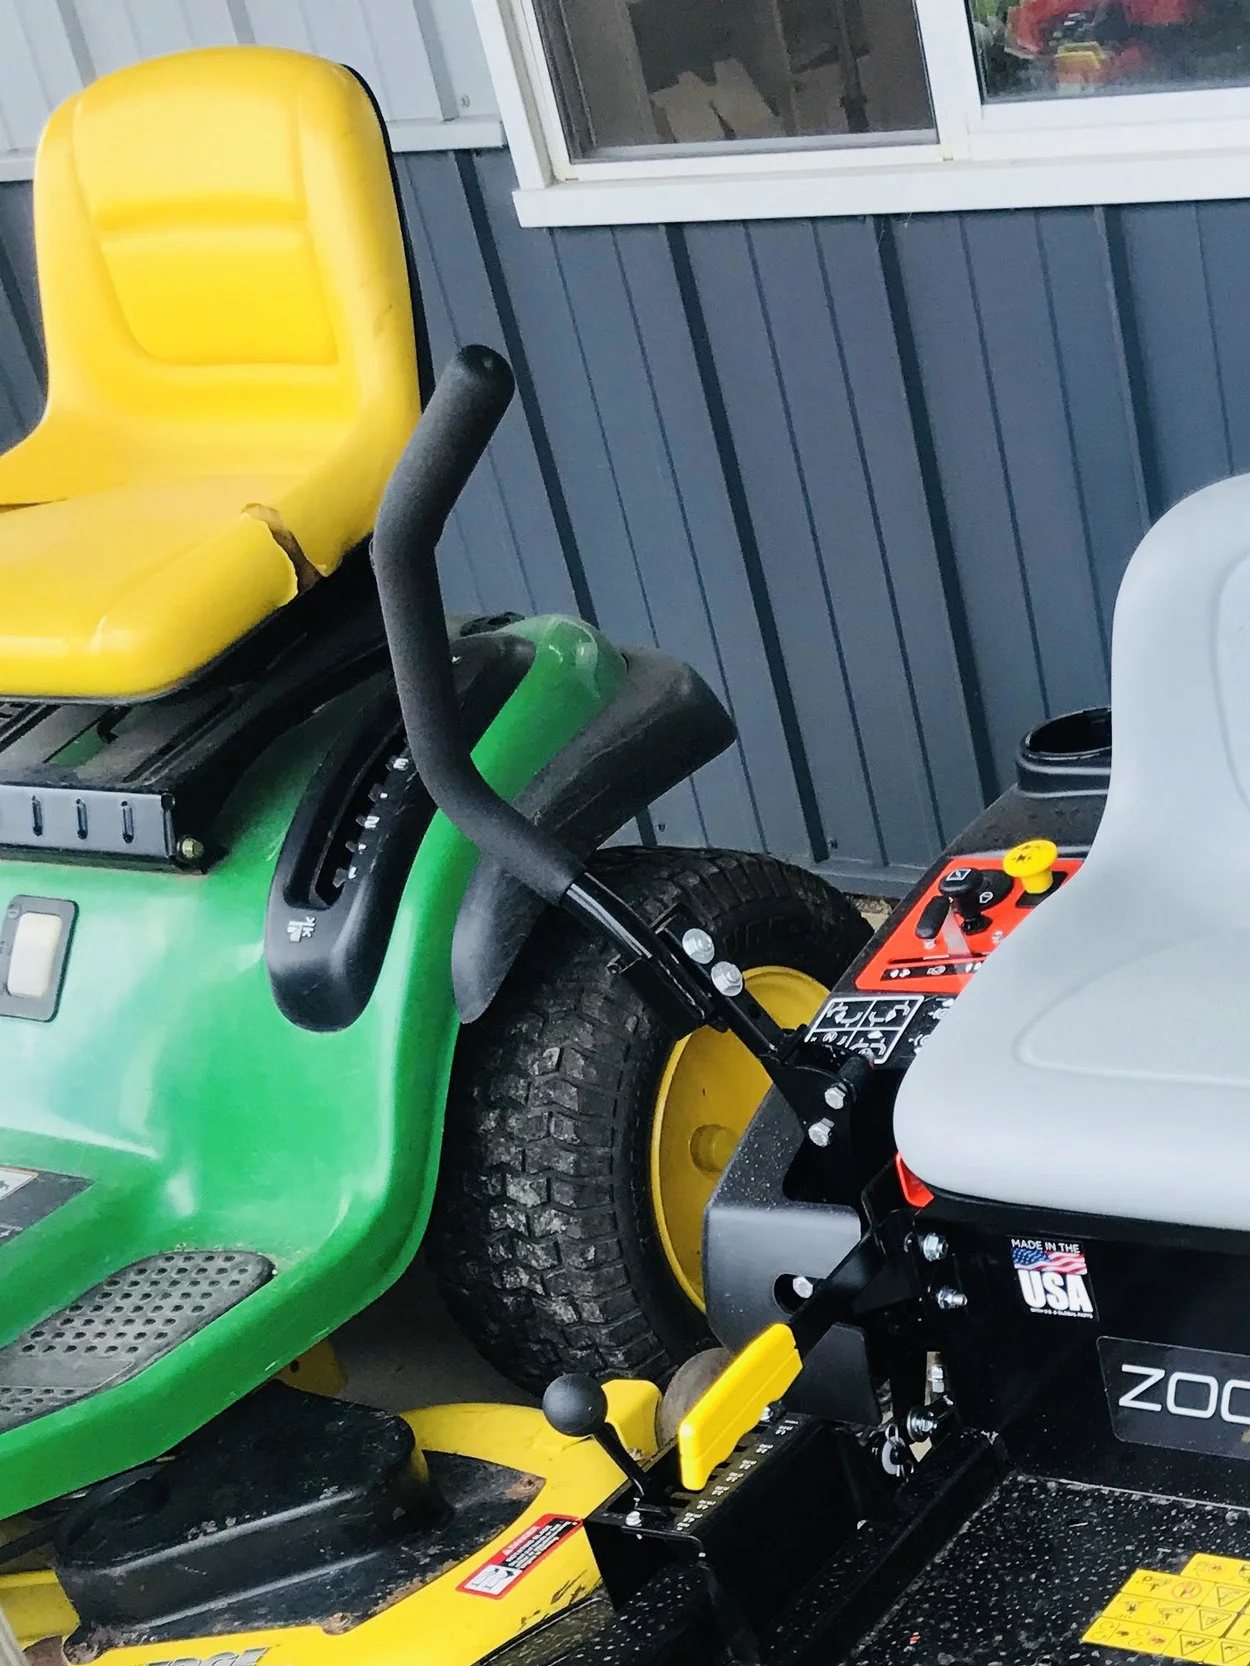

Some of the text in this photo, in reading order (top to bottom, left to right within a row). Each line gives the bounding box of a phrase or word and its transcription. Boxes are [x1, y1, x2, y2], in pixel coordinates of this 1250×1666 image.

[1011, 1238, 1081, 1254] MADE IN THE
[1018, 1268, 1094, 1313] USA
